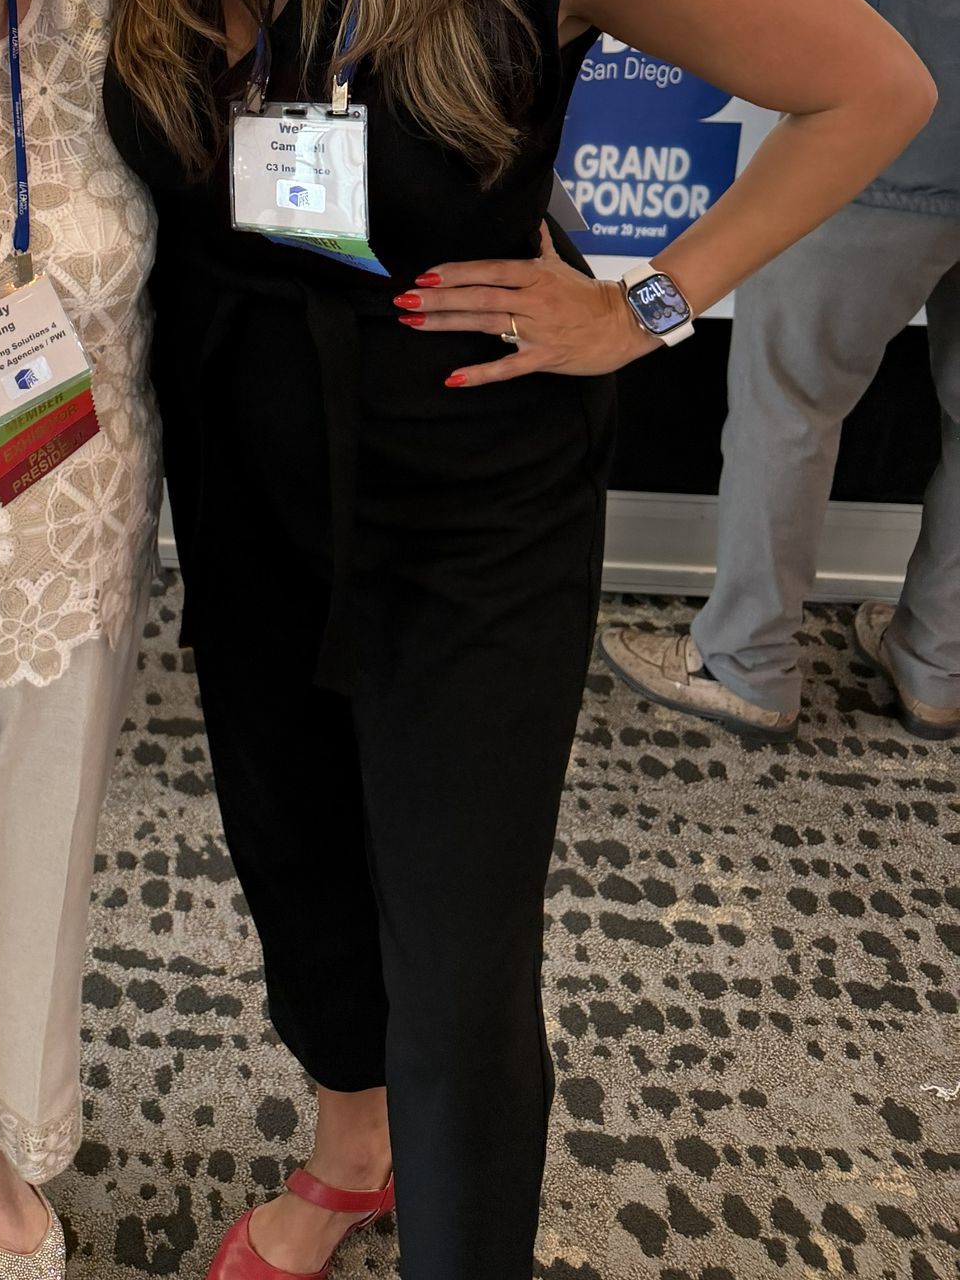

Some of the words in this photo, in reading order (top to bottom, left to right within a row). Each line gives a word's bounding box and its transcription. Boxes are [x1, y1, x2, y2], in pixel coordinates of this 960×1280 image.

[580, 58, 618, 81] San
[625, 57, 683, 88] Diego
[265, 163, 279, 172] C3
[574, 143, 690, 182] GRAND
[592, 222, 619, 236] Over
[635, 223, 668, 239] years!
[636, 282, 666, 305] 11:22
[7, 344, 45, 368] Agencies
[49, 330, 67, 345] PWI
[11, 326, 51, 351] Solutions
[50, 321, 58, 330] 4
